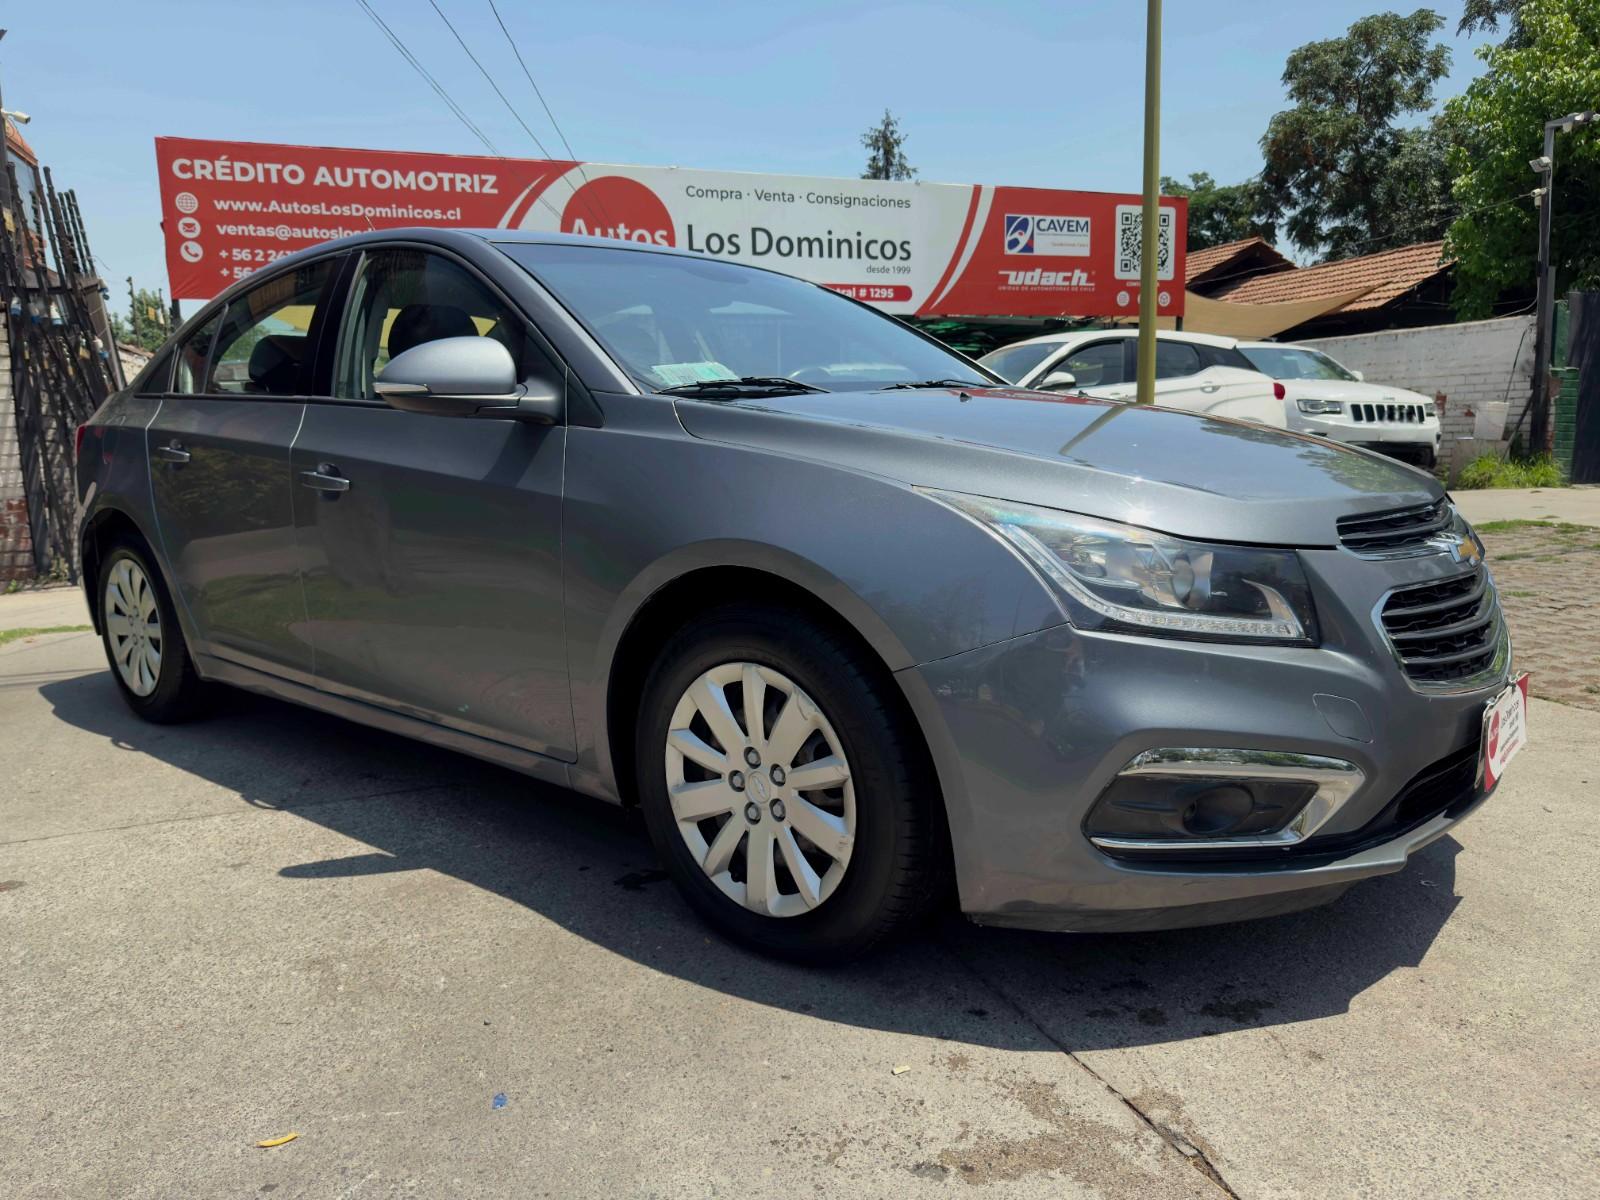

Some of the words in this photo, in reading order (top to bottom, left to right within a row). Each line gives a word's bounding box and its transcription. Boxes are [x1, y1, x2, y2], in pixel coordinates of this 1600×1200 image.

[172, 155, 305, 185] CRÉDITO
[313, 166, 498, 194] AUTOMOTRIZ
[685, 185, 742, 202] Compra
[754, 188, 795, 203] Venta
[806, 192, 912, 209] Consignaciones
[213, 199, 461, 220] www.AutosLosDominicos.cl
[1036, 218, 1089, 232] CAVEM
[687, 224, 741, 255] Los
[751, 227, 912, 261] Dominicos
[232, 248, 252, 261] 56
[254, 248, 264, 262] 2
[866, 264, 890, 274] desde
[892, 265, 911, 275] 1999
[859, 288, 867, 298] #
[869, 288, 894, 299] 1295
